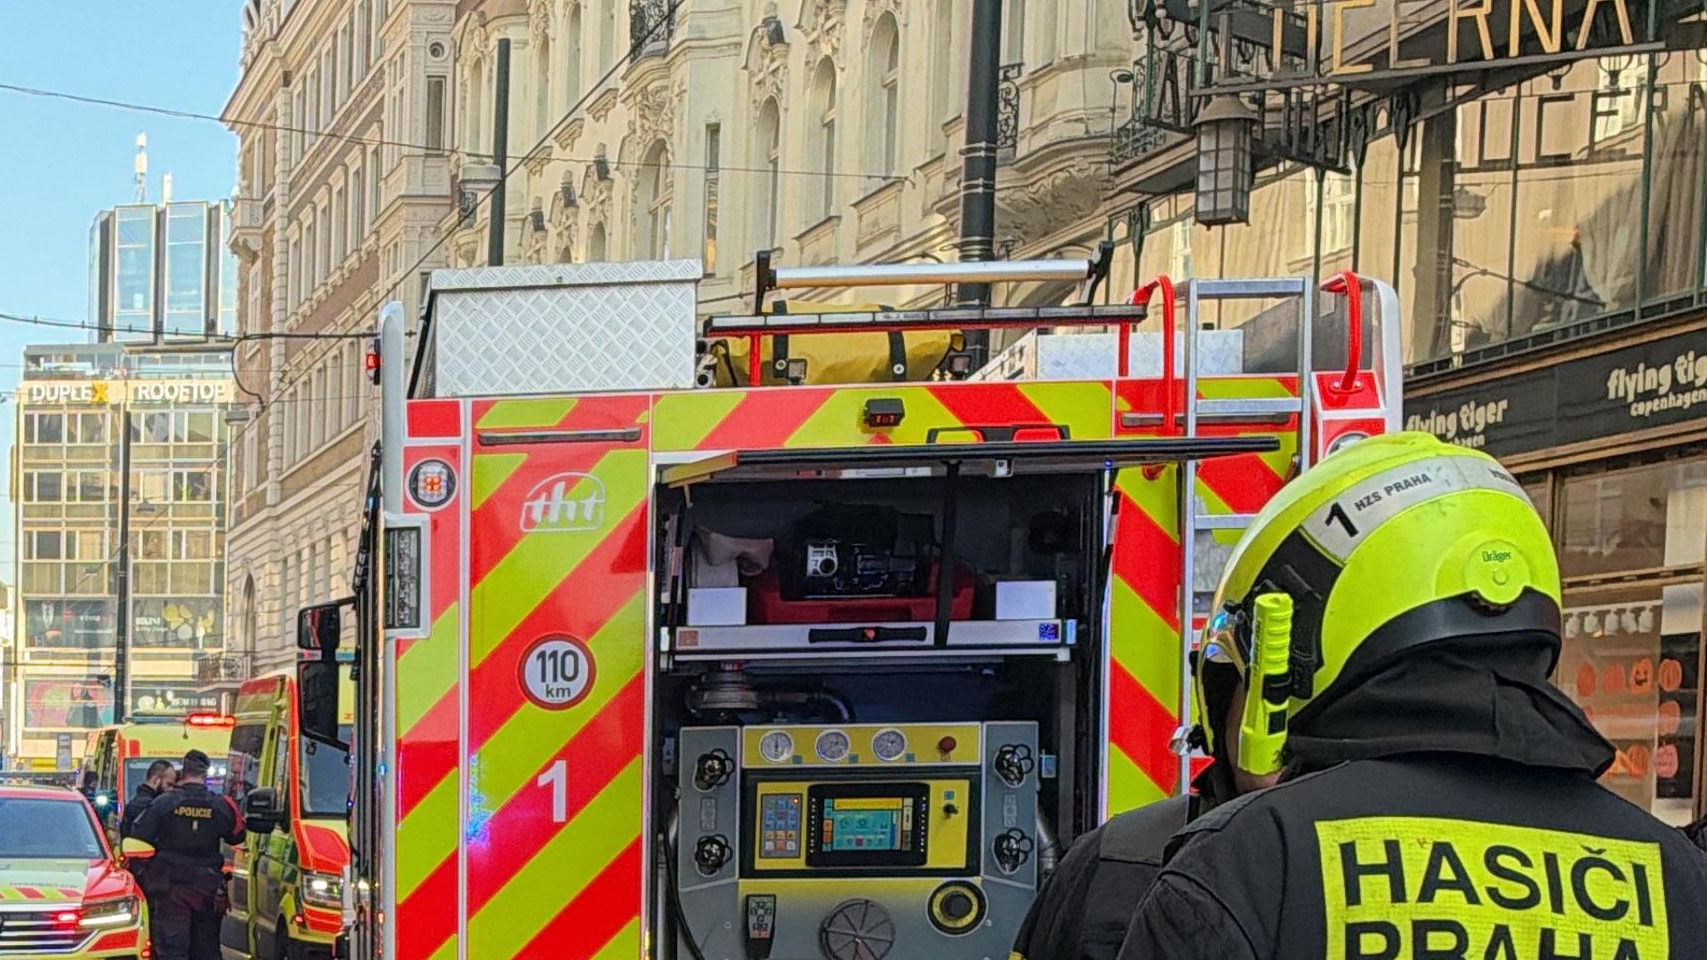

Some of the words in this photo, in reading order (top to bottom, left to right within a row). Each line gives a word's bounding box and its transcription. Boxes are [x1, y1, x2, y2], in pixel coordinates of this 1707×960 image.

[32, 383, 109, 403] DUPLEX
[137, 383, 226, 401] ROOFTOP
[1607, 362, 1672, 403] flying
[1406, 410, 1457, 438] flying
[1459, 399, 1509, 432] tiger
[1630, 388, 1707, 417] copenhagen
[1324, 501, 1359, 538] 1
[1354, 491, 1383, 511] HZS
[1384, 472, 1433, 496] PRAHA
[1482, 550, 1512, 563] Dräger
[536, 650, 579, 683] 110
[546, 683, 572, 698] km
[537, 760, 567, 823] 1
[178, 806, 213, 819] POLICIE
[1339, 837, 1654, 927] HASIČI
